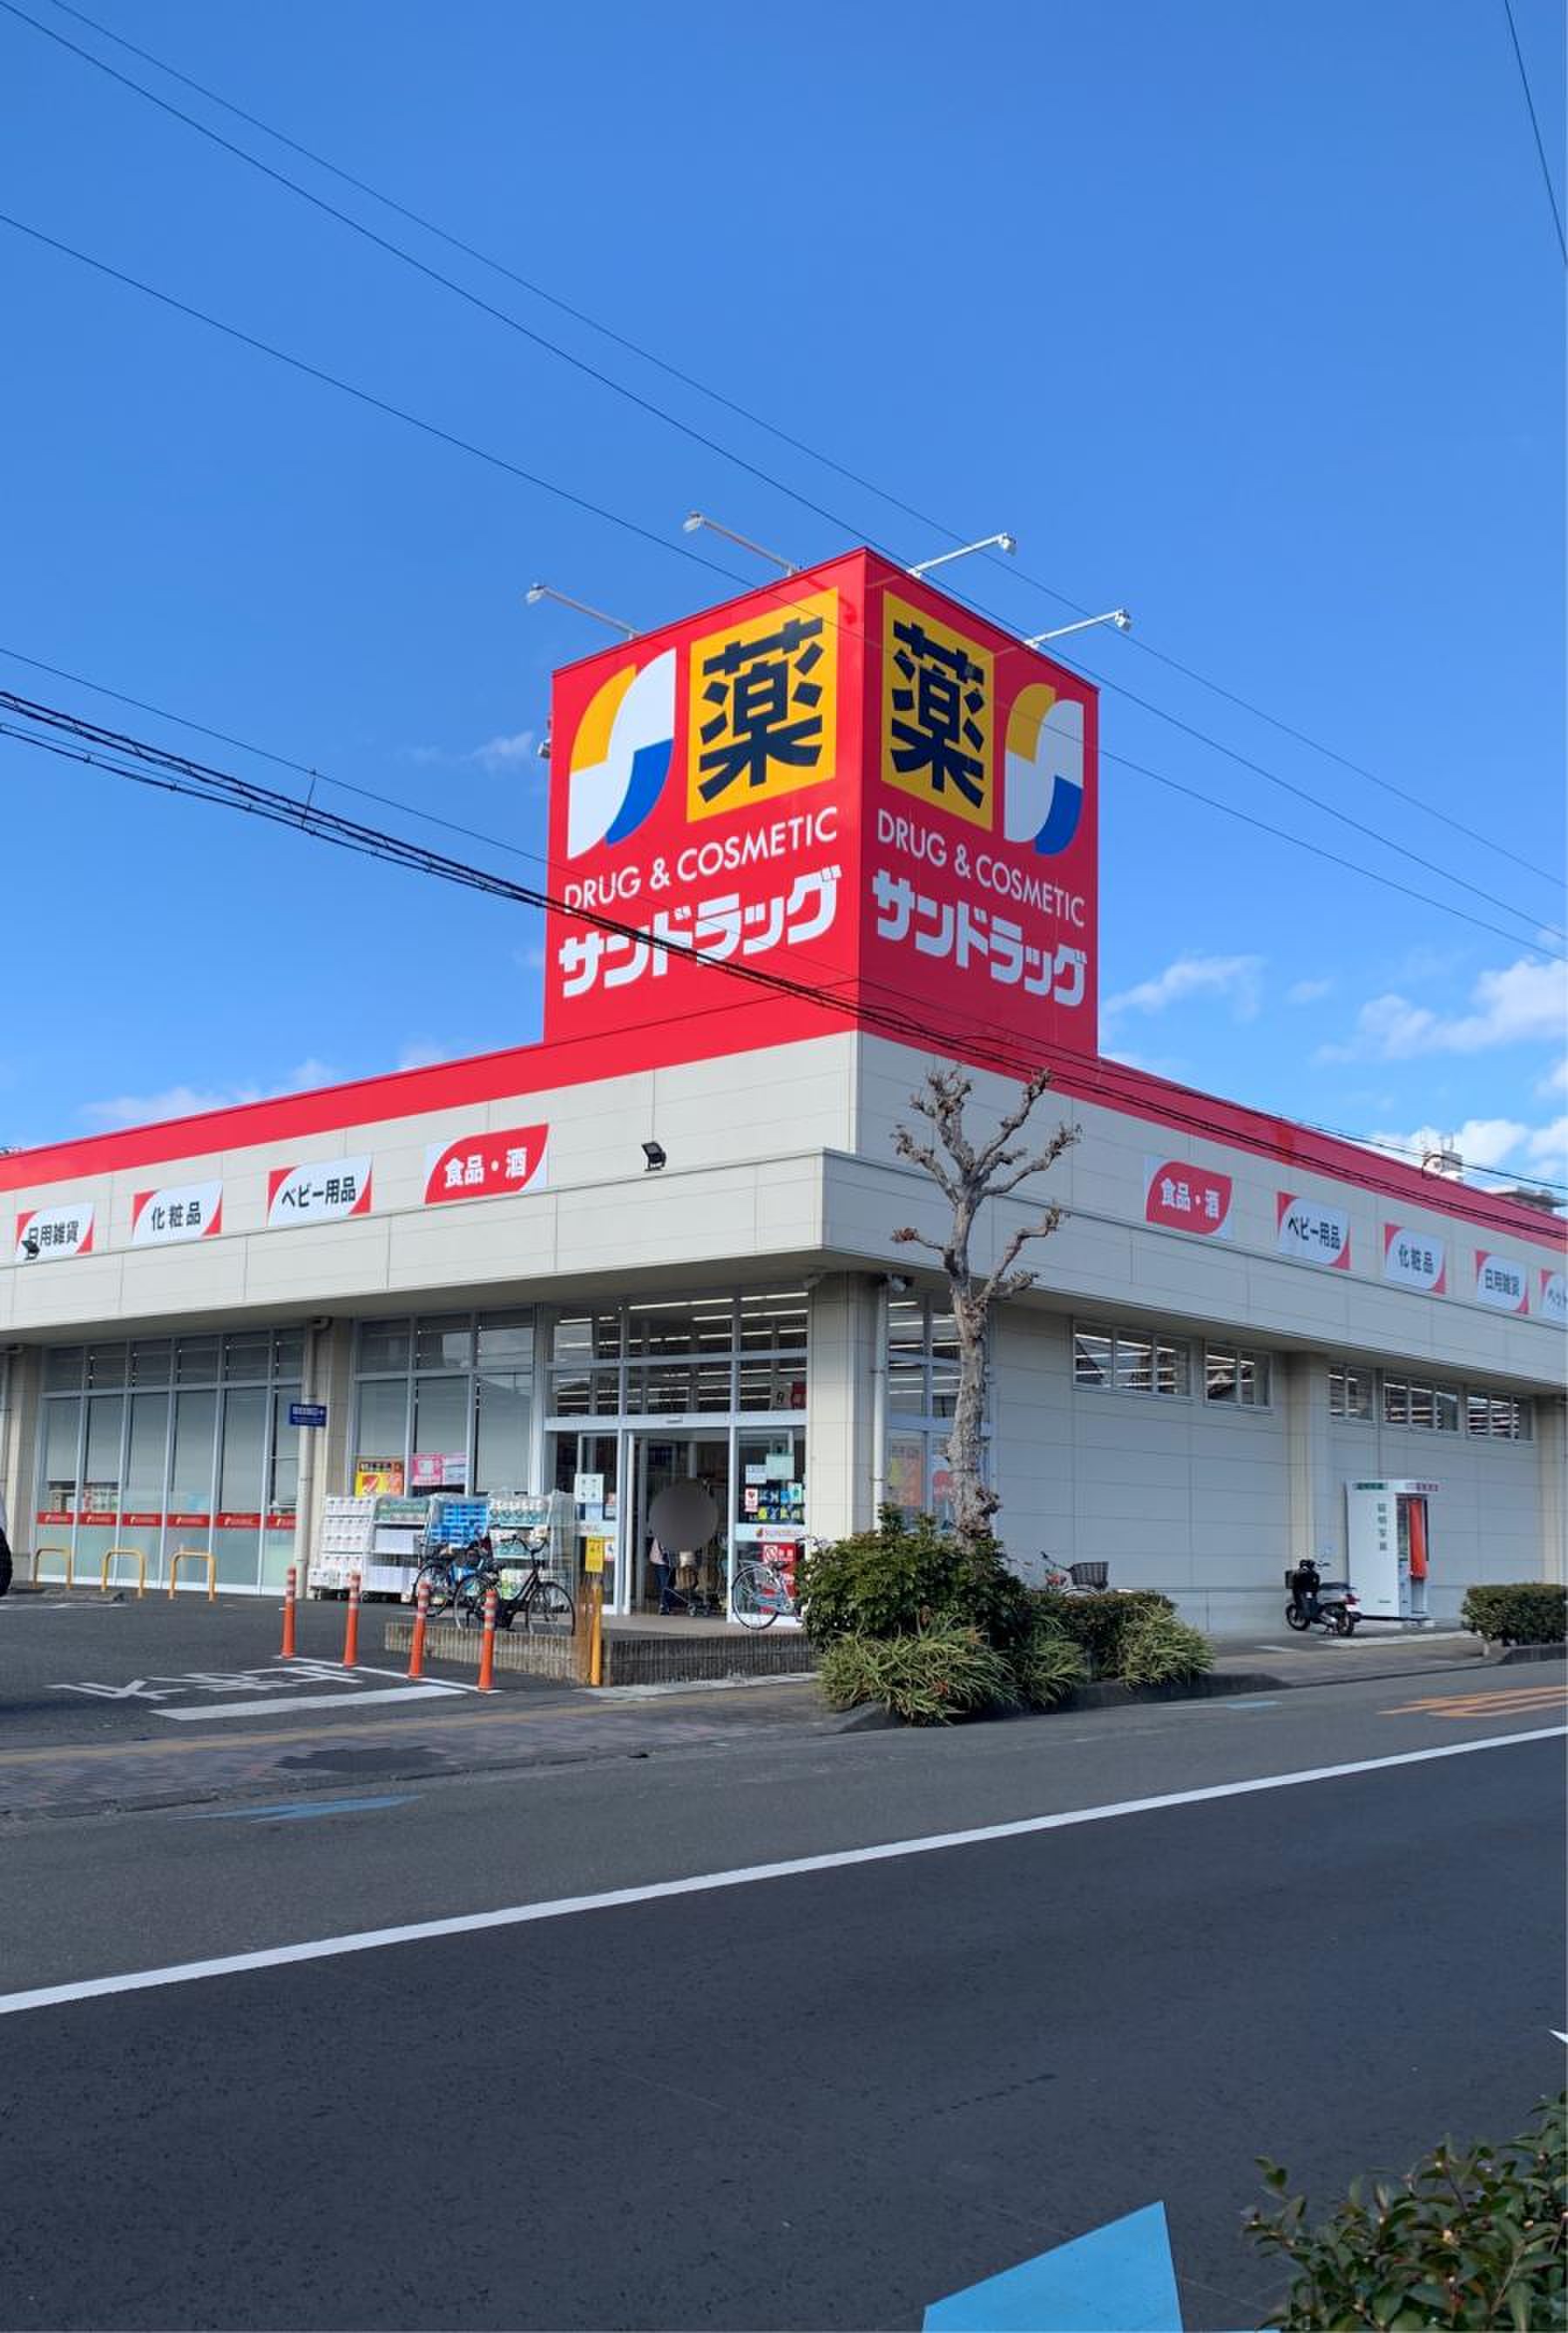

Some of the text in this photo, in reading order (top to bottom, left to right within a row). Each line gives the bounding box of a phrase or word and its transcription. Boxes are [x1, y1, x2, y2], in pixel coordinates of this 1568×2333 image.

[698, 617, 824, 802] 薬
[891, 619, 984, 809] 薬
[564, 807, 838, 914] DRUG & COSMETIC
[878, 809, 1085, 928] DRUG & COSMETIC
[558, 863, 841, 998] サンドラッグ
[872, 869, 1087, 1007] サンドラッグ
[151, 1201, 201, 1231] 化粧品
[280, 1176, 356, 1208] ベビー用品
[445, 1146, 528, 1188] 食品・酒
[1288, 1216, 1341, 1250] ベビー用品
[1398, 1244, 1434, 1275] 化粧品
